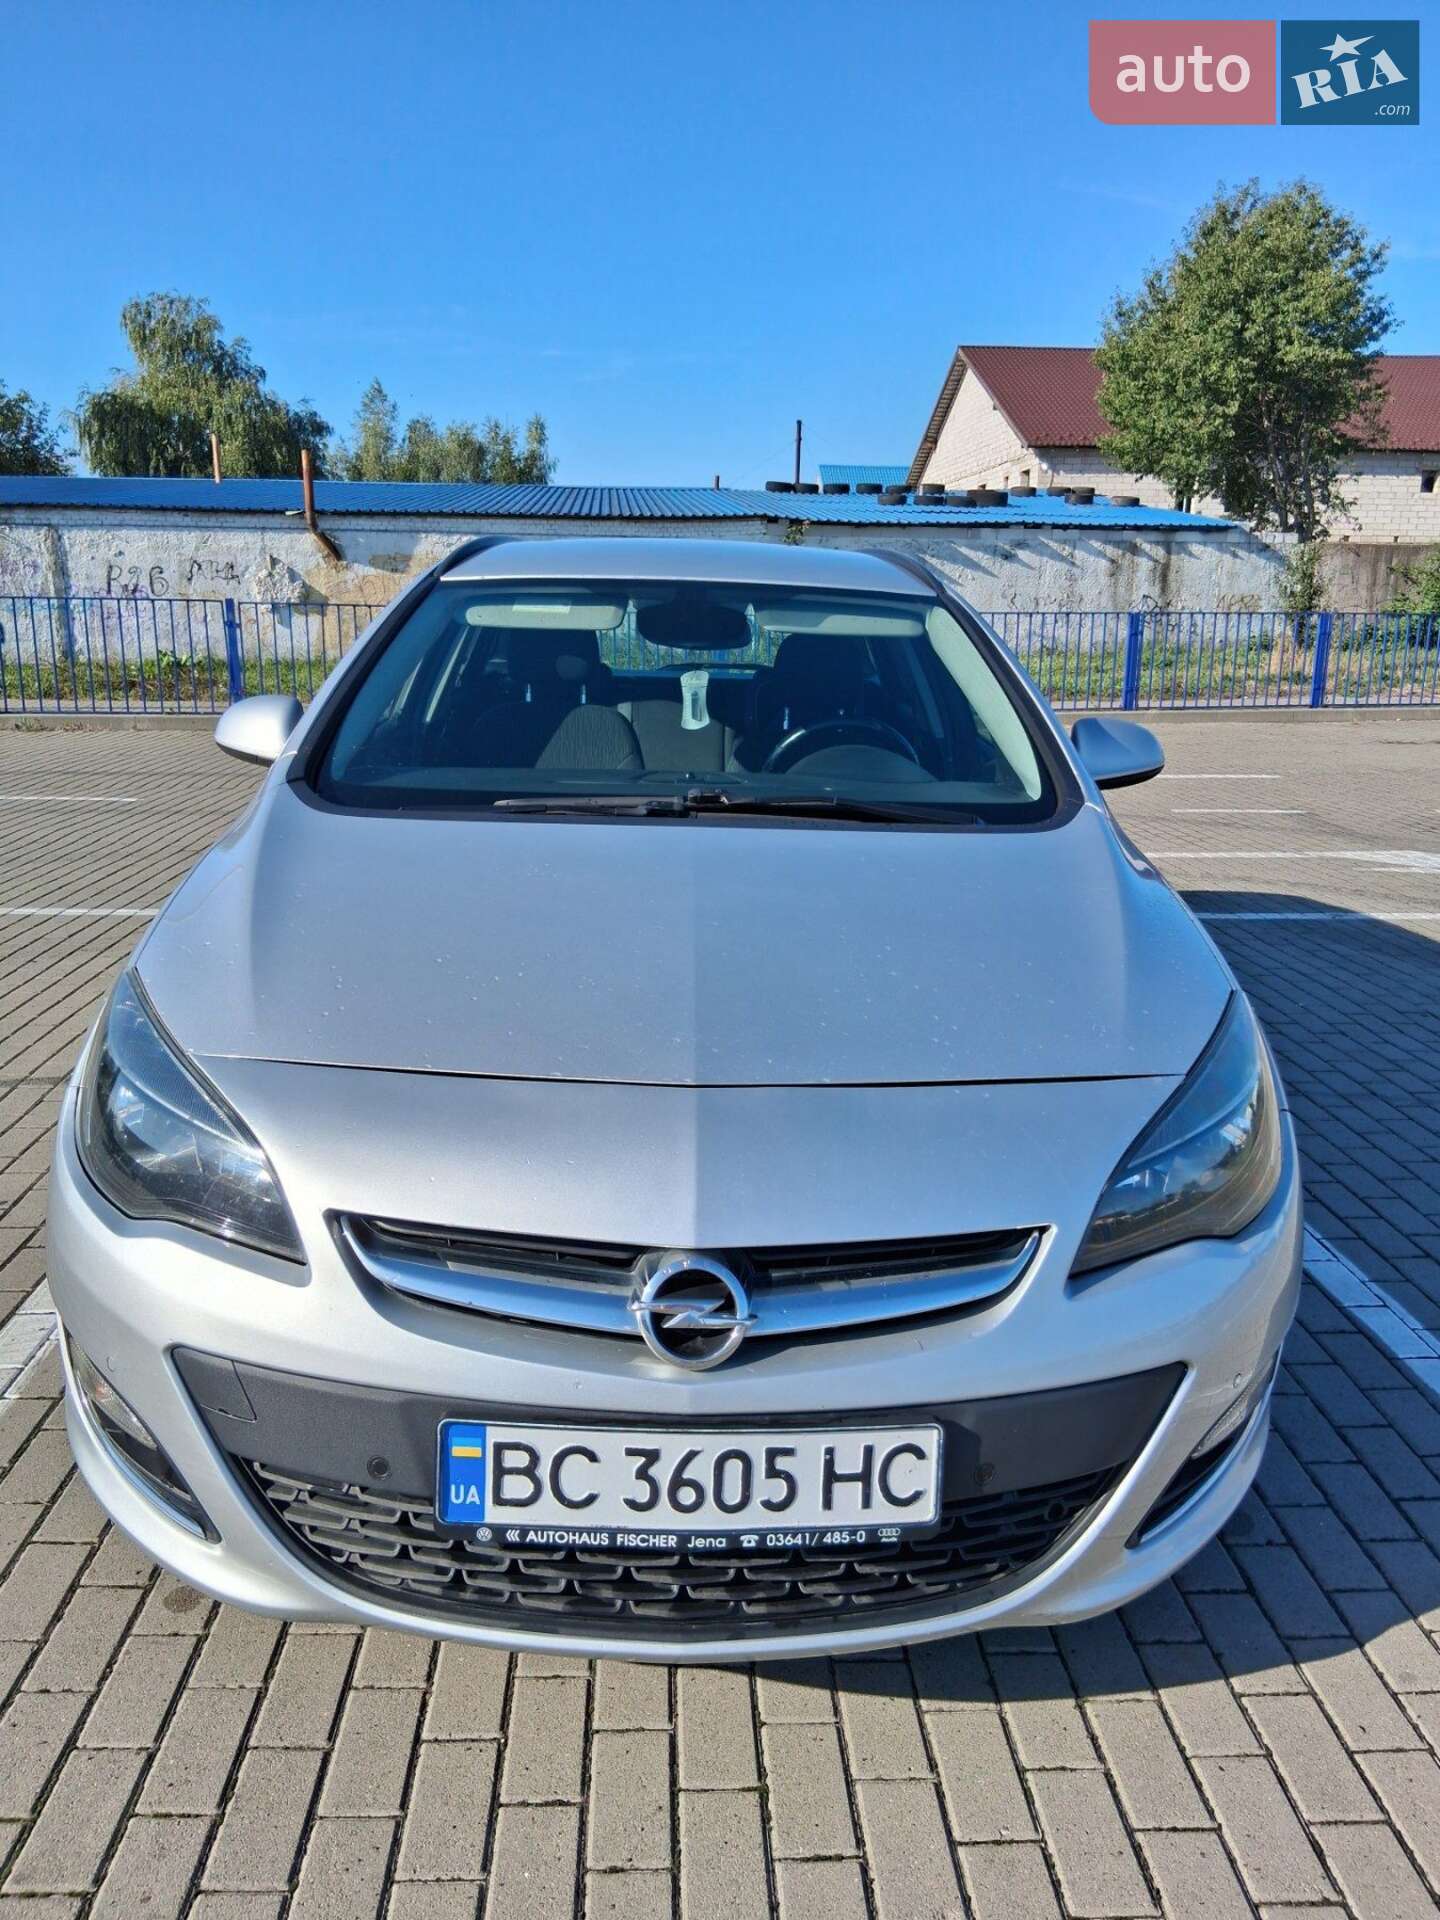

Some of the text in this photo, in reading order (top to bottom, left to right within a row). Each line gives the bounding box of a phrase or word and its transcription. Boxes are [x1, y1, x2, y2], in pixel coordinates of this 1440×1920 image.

[492, 1441, 927, 1515] BC 3605 HC
[450, 1483, 481, 1506] UA
[526, 1529, 609, 1546] AUTOHAUS
[616, 1533, 677, 1548] FISCHER
[687, 1535, 727, 1548] Jena
